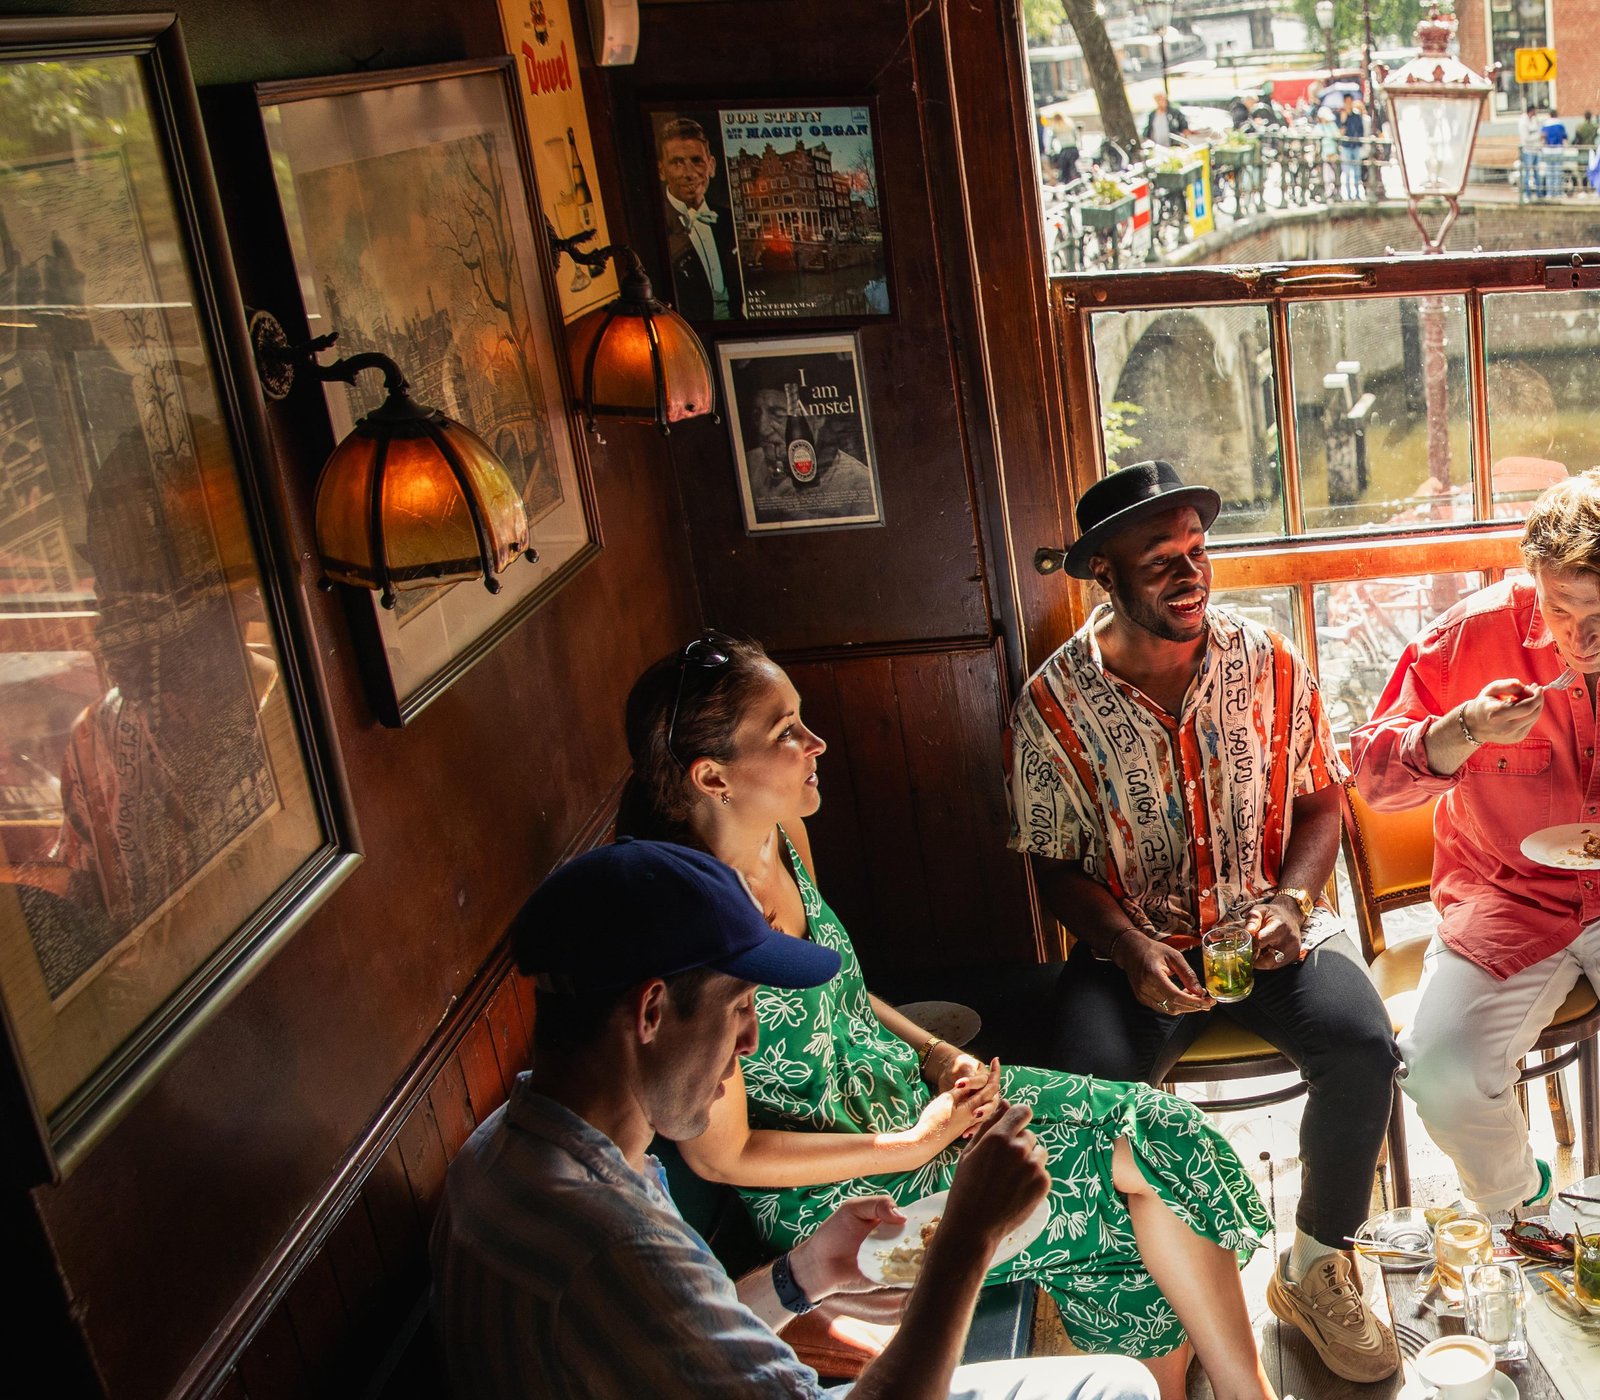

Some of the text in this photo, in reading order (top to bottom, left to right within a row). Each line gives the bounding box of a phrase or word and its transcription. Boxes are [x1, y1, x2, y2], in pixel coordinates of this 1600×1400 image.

[521, 40, 573, 96] Duvel
[1526, 57, 1539, 72] A
[724, 111, 822, 125] COR STEYN
[746, 124, 869, 139] MAGIC ORGAN
[750, 302, 817, 310] AMSTERDAMSE
[798, 369, 807, 387] I
[812, 385, 839, 399] am
[795, 395, 855, 416] Amstel
